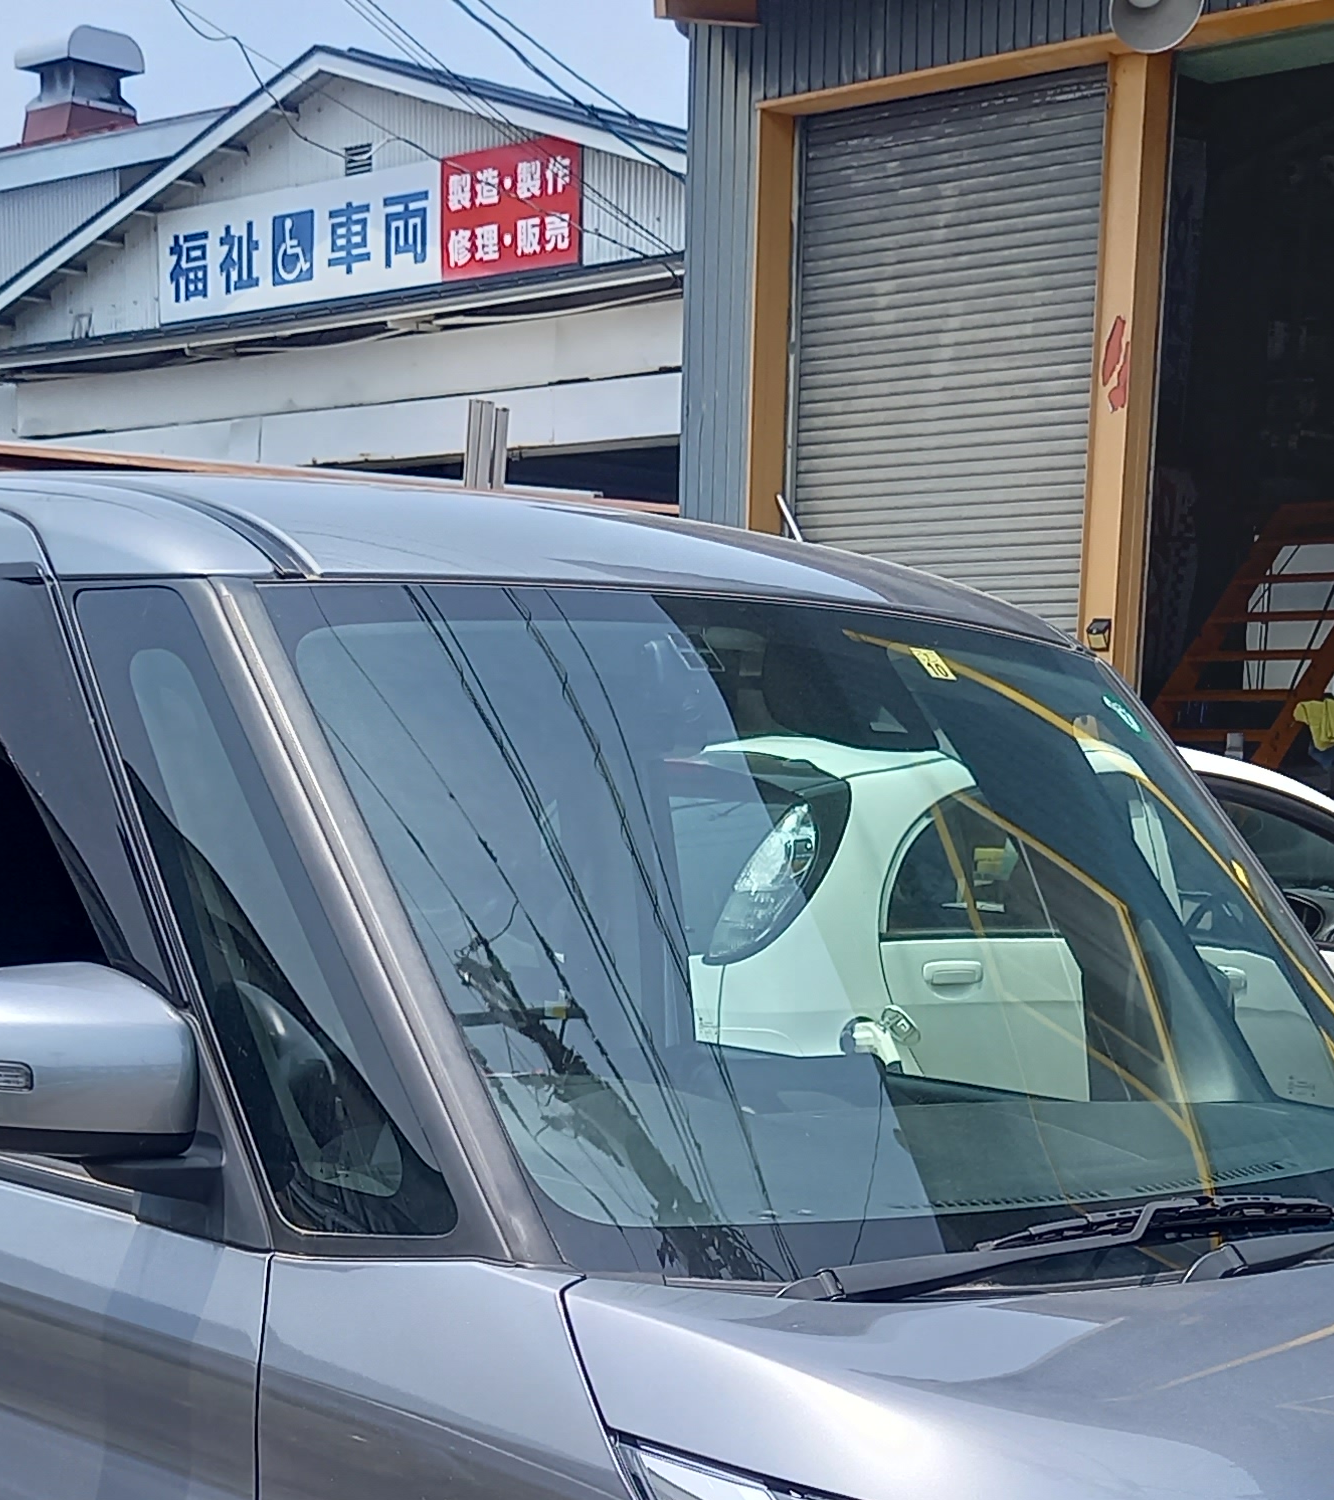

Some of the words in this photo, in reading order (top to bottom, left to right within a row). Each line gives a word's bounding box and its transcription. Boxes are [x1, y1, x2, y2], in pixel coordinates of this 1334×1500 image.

[169, 221, 261, 302] 福祉
[327, 189, 430, 275] 車両
[448, 212, 571, 268] 修理・販売
